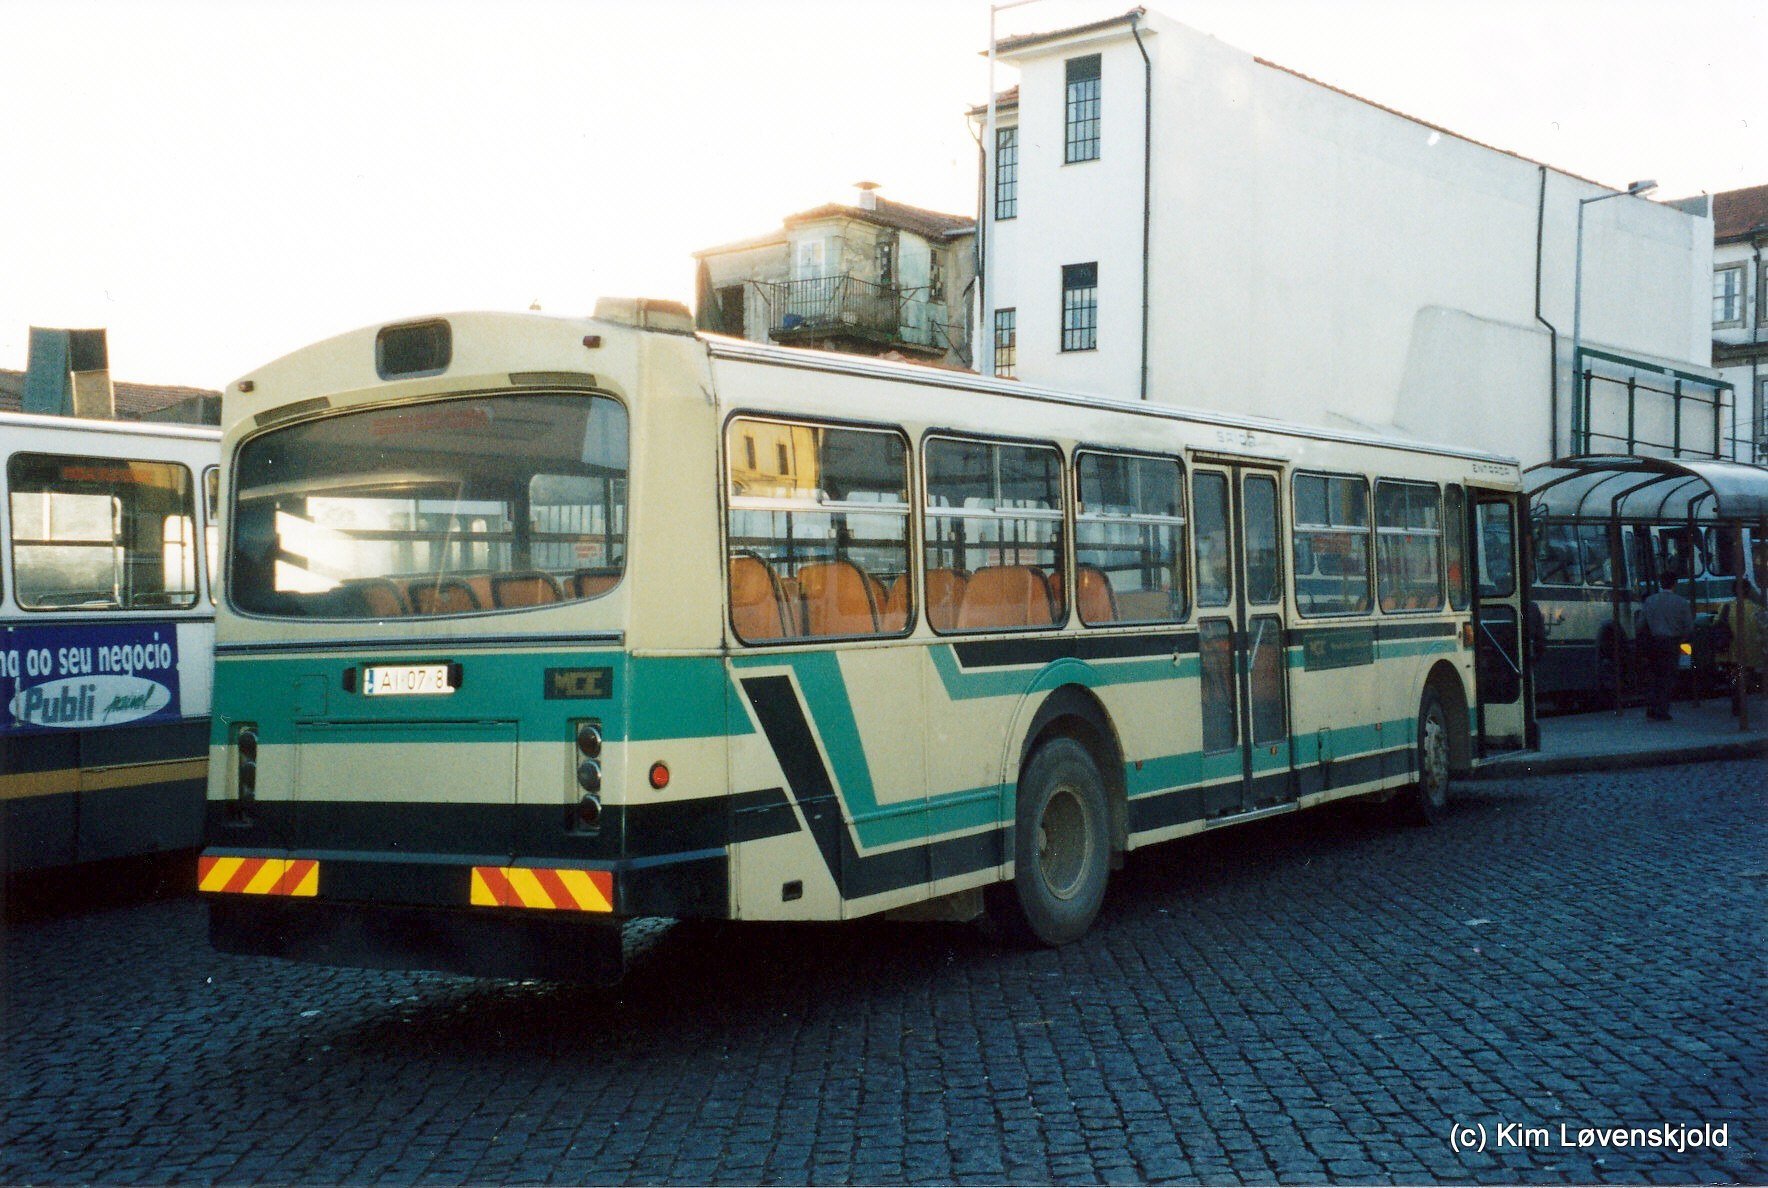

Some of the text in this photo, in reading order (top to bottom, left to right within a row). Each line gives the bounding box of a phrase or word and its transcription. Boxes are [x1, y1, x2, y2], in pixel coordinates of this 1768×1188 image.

[26, 648, 52, 676] ao
[58, 646, 92, 675] seu
[24, 684, 96, 722] Publi
